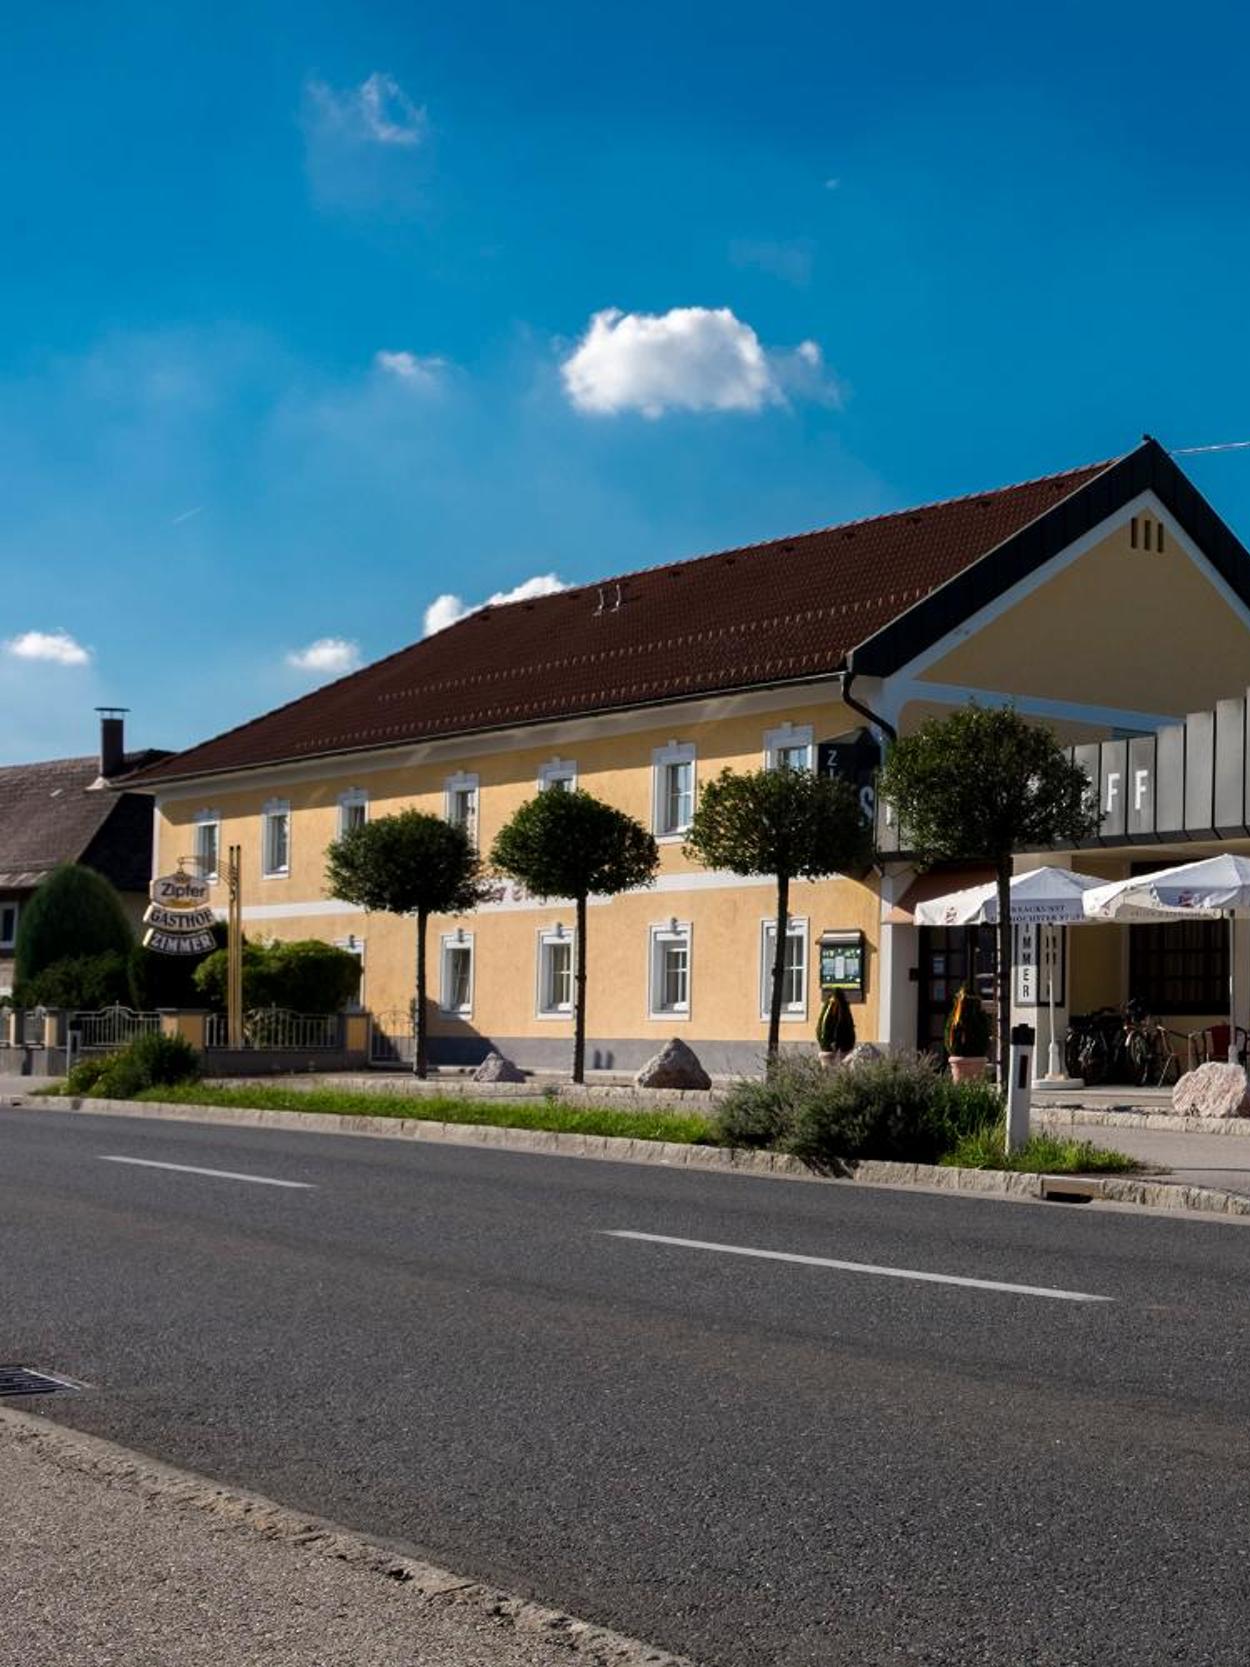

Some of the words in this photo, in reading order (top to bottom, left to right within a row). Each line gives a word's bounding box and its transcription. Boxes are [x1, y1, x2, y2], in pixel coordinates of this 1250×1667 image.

[161, 882, 206, 898] Zipfer
[151, 910, 213, 928] GASTHOF
[151, 932, 212, 952] ZIMMER
[1022, 923, 1032, 998] IMMER
